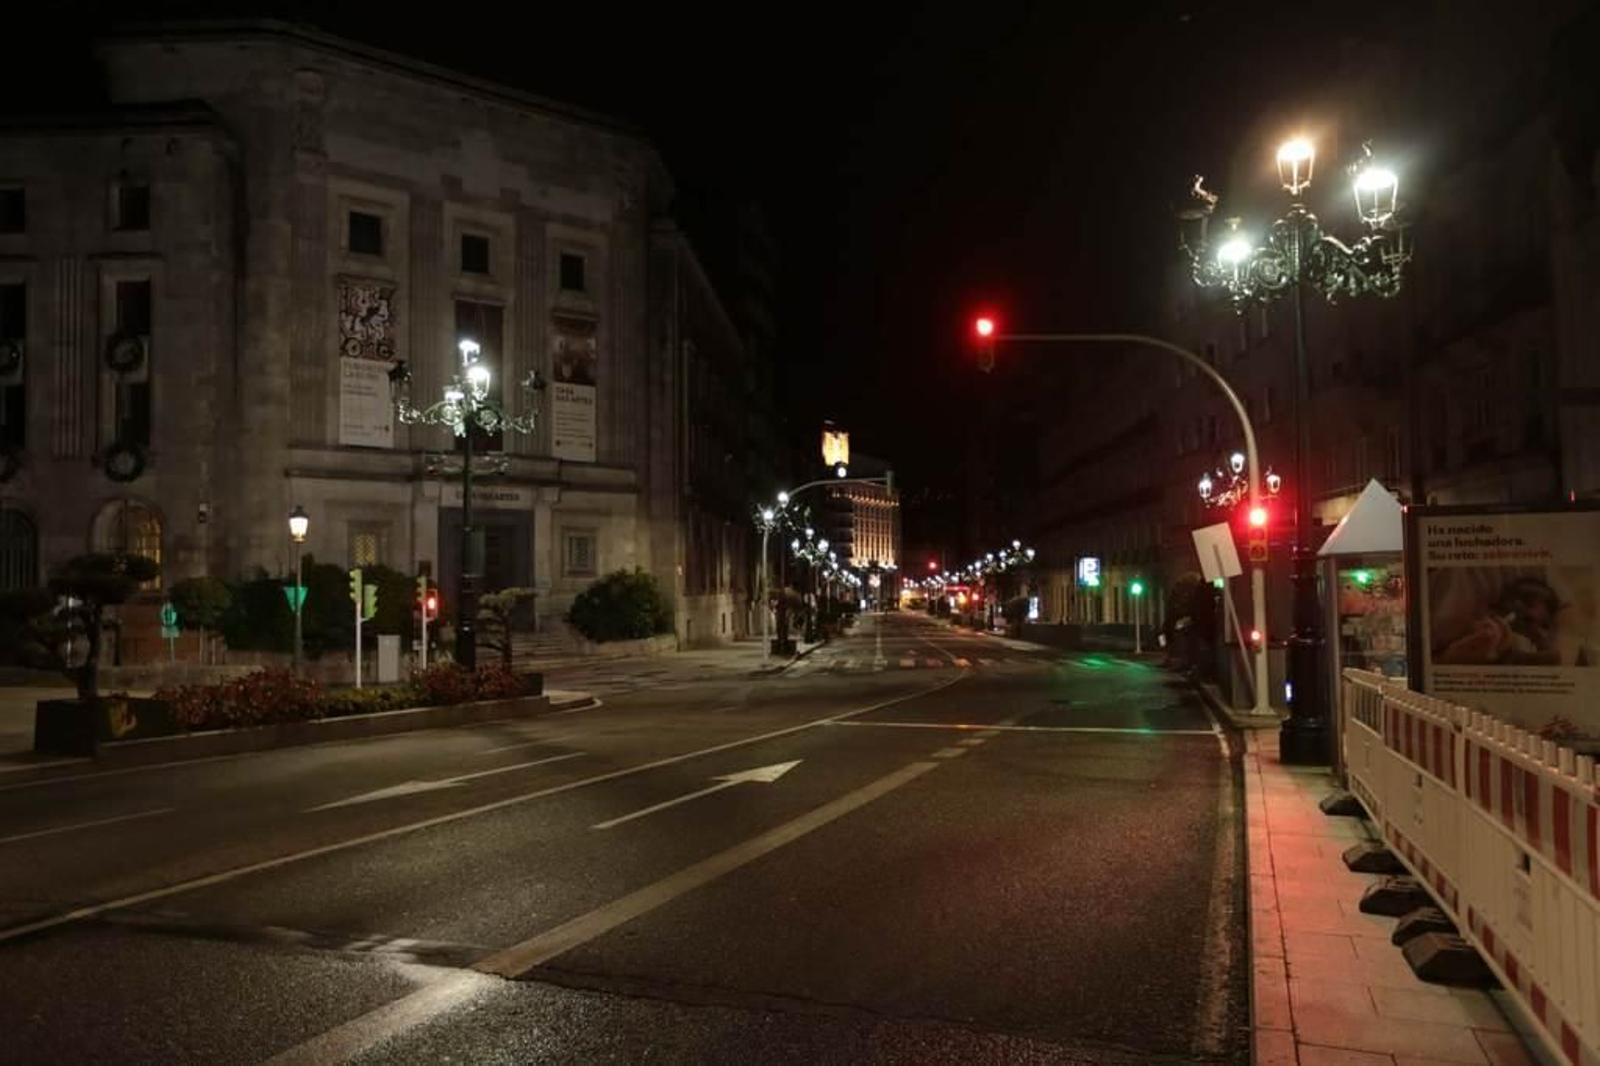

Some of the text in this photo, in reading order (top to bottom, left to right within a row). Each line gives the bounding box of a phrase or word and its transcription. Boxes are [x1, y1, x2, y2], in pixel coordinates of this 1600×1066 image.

[1427, 524, 1493, 536] Ha nacido
[1428, 539, 1452, 548] una
